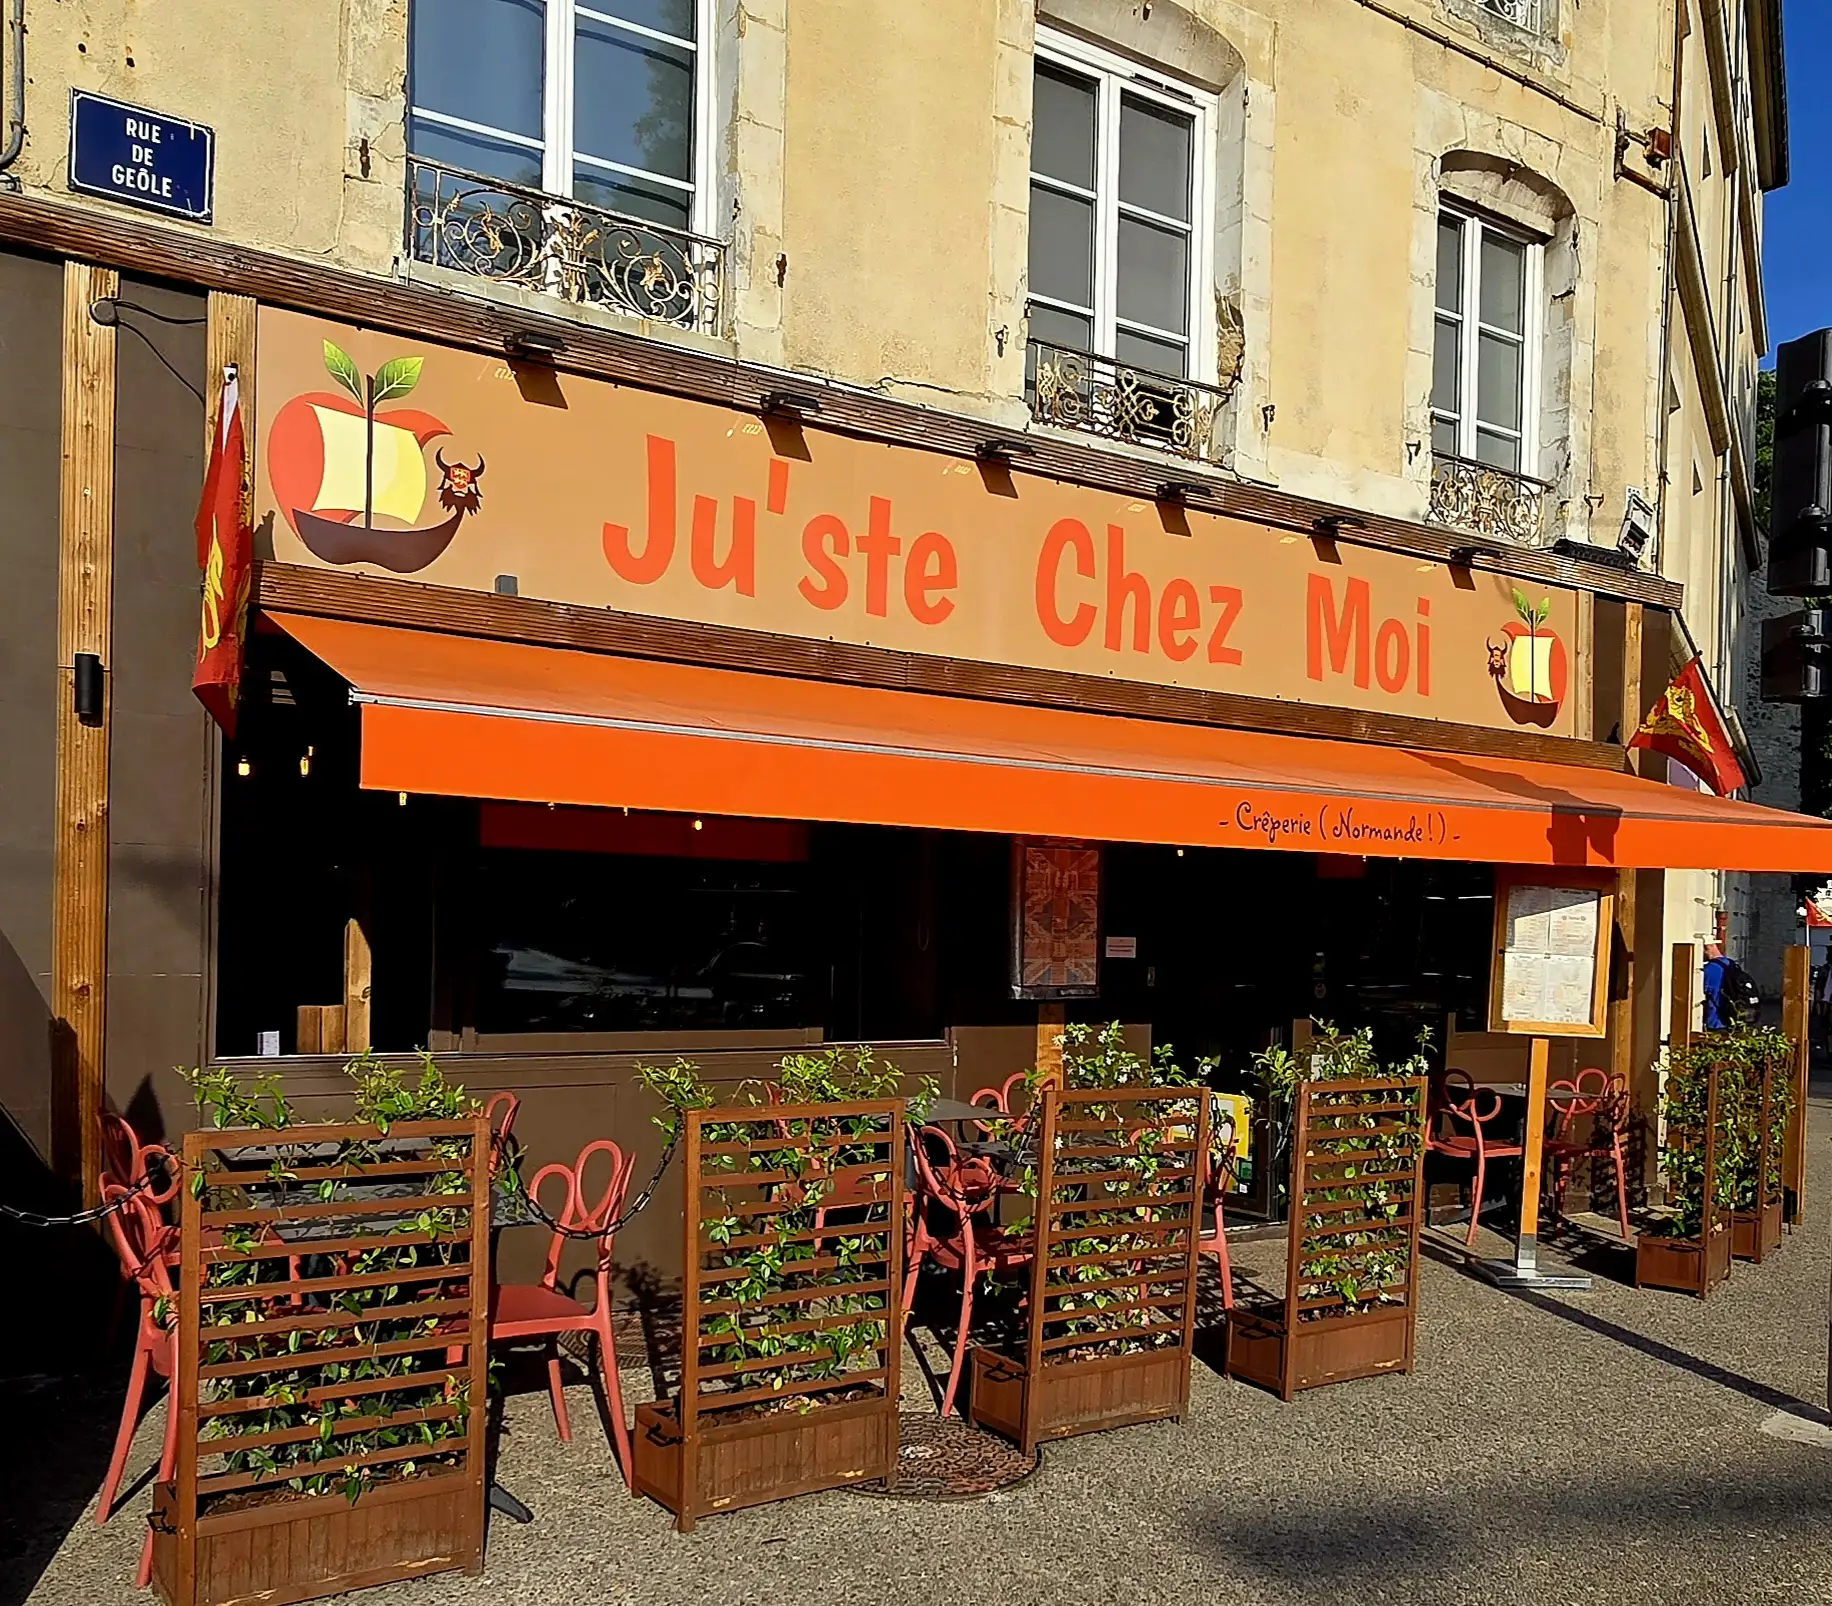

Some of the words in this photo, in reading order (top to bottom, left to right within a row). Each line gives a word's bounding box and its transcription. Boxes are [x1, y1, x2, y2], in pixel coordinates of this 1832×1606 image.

[126, 118, 161, 143] RUE
[132, 144, 154, 166] DE
[111, 164, 173, 198] GEÔLE
[602, 433, 958, 626] Ju'ste
[1035, 517, 1244, 667] Chez
[1306, 572, 1431, 698] Moi
[1236, 800, 1312, 843] Crêperie
